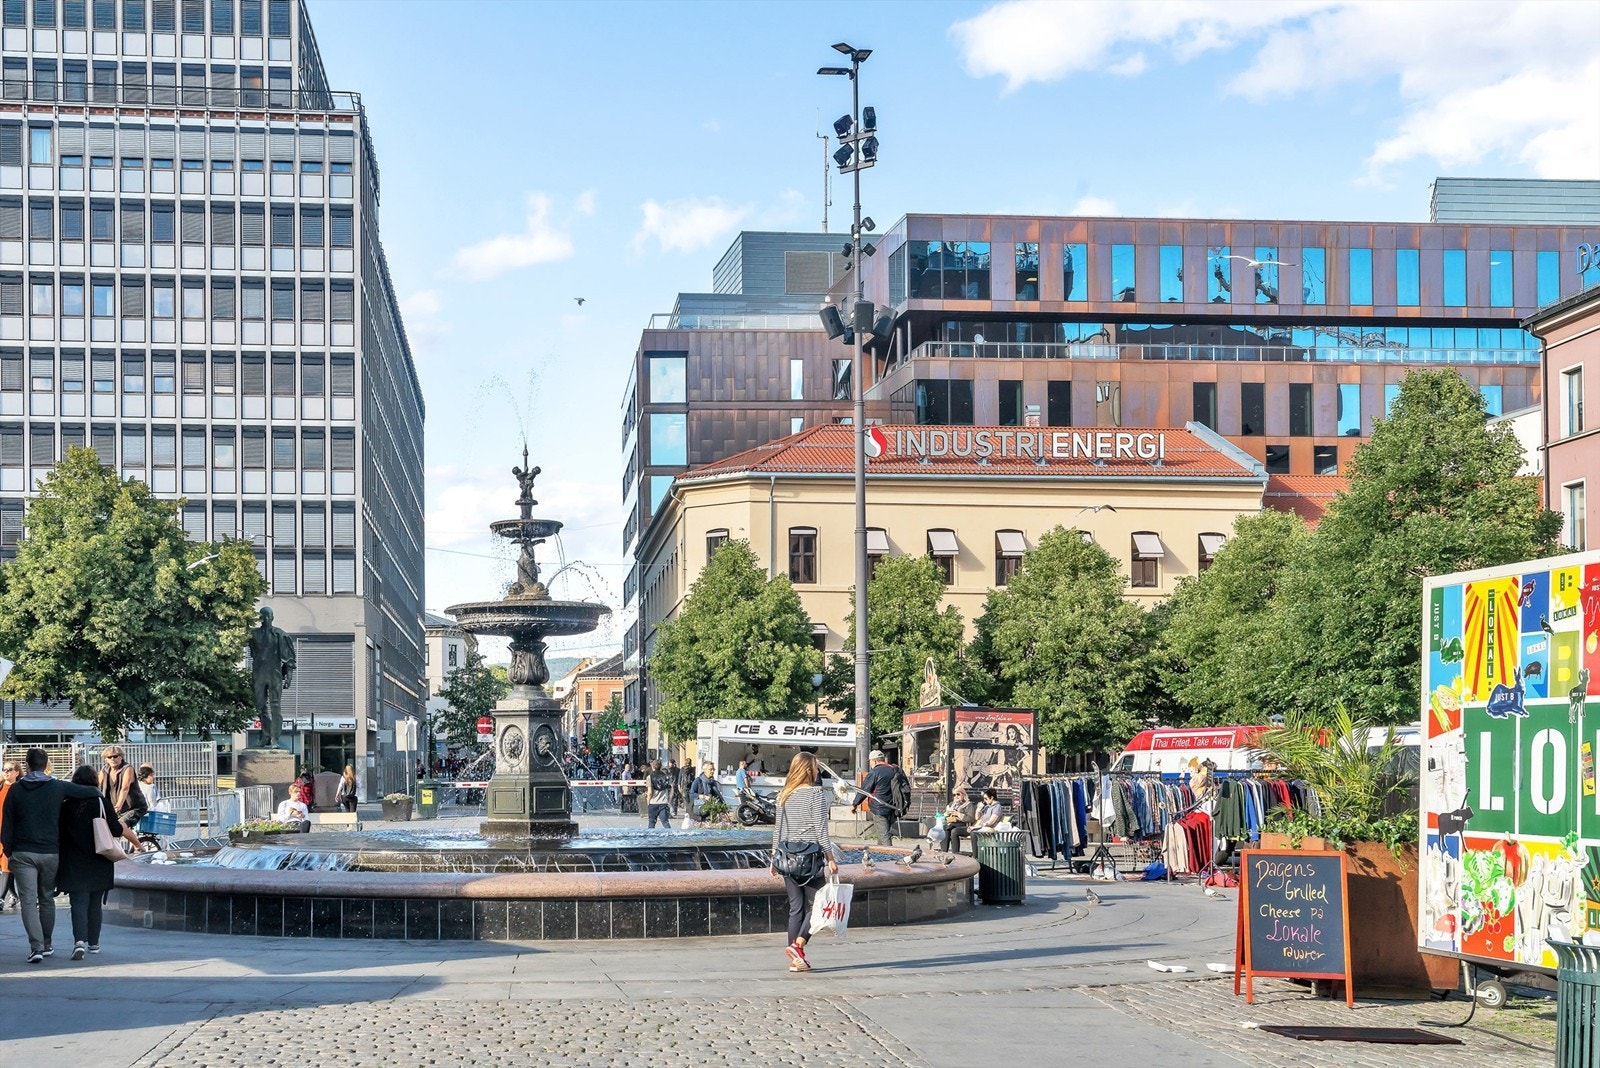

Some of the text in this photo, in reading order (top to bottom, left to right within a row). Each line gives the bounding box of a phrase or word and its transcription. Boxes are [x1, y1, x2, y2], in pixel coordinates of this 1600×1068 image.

[896, 430, 1165, 459] INDUSTRI ENERGI
[734, 724, 849, 737] ICE & SHAKES
[1155, 738, 1169, 748] Thai
[1193, 737, 1209, 746] Take
[1212, 736, 1232, 747] Away
[1255, 859, 1316, 891] Dagens
[1285, 879, 1329, 904] Grilled
[1259, 903, 1301, 918] Cheese
[1265, 919, 1324, 945] Lokale
